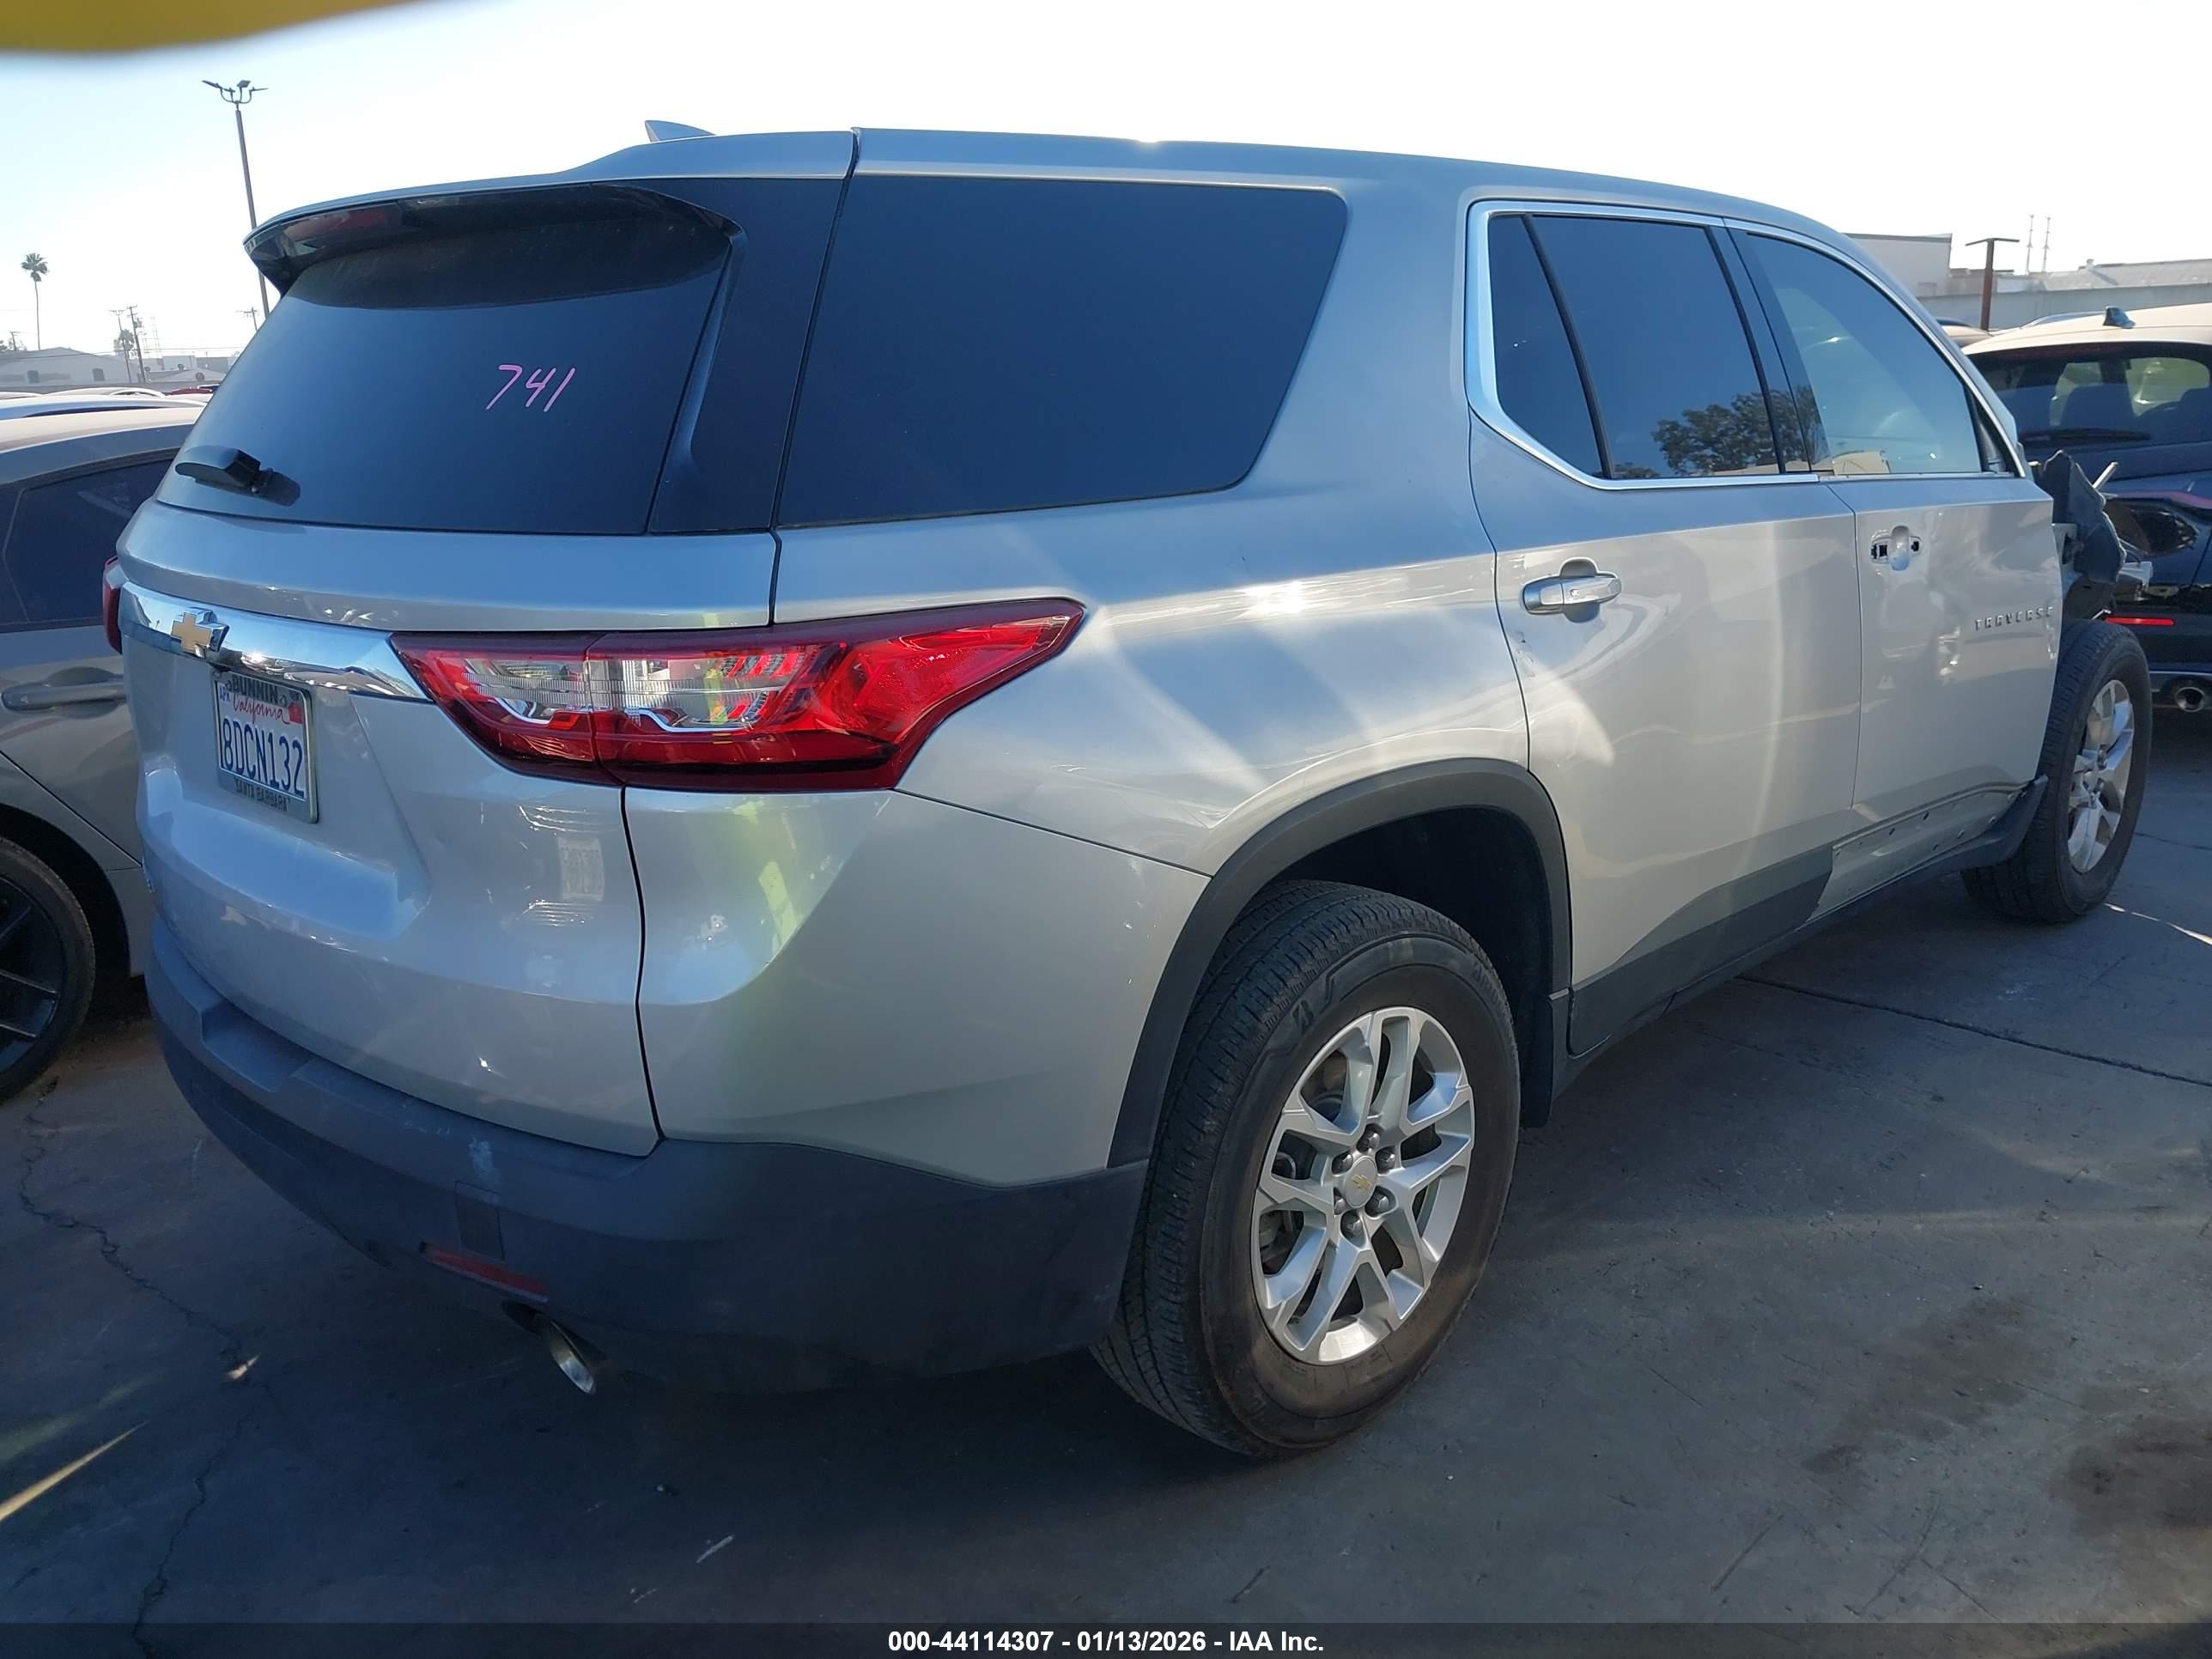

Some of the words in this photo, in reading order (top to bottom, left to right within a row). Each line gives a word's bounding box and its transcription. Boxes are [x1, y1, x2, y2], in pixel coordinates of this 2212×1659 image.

[485, 363, 576, 412] 741
[1975, 606, 2055, 631] TRAVERSE
[222, 717, 305, 799] 8DCN132
